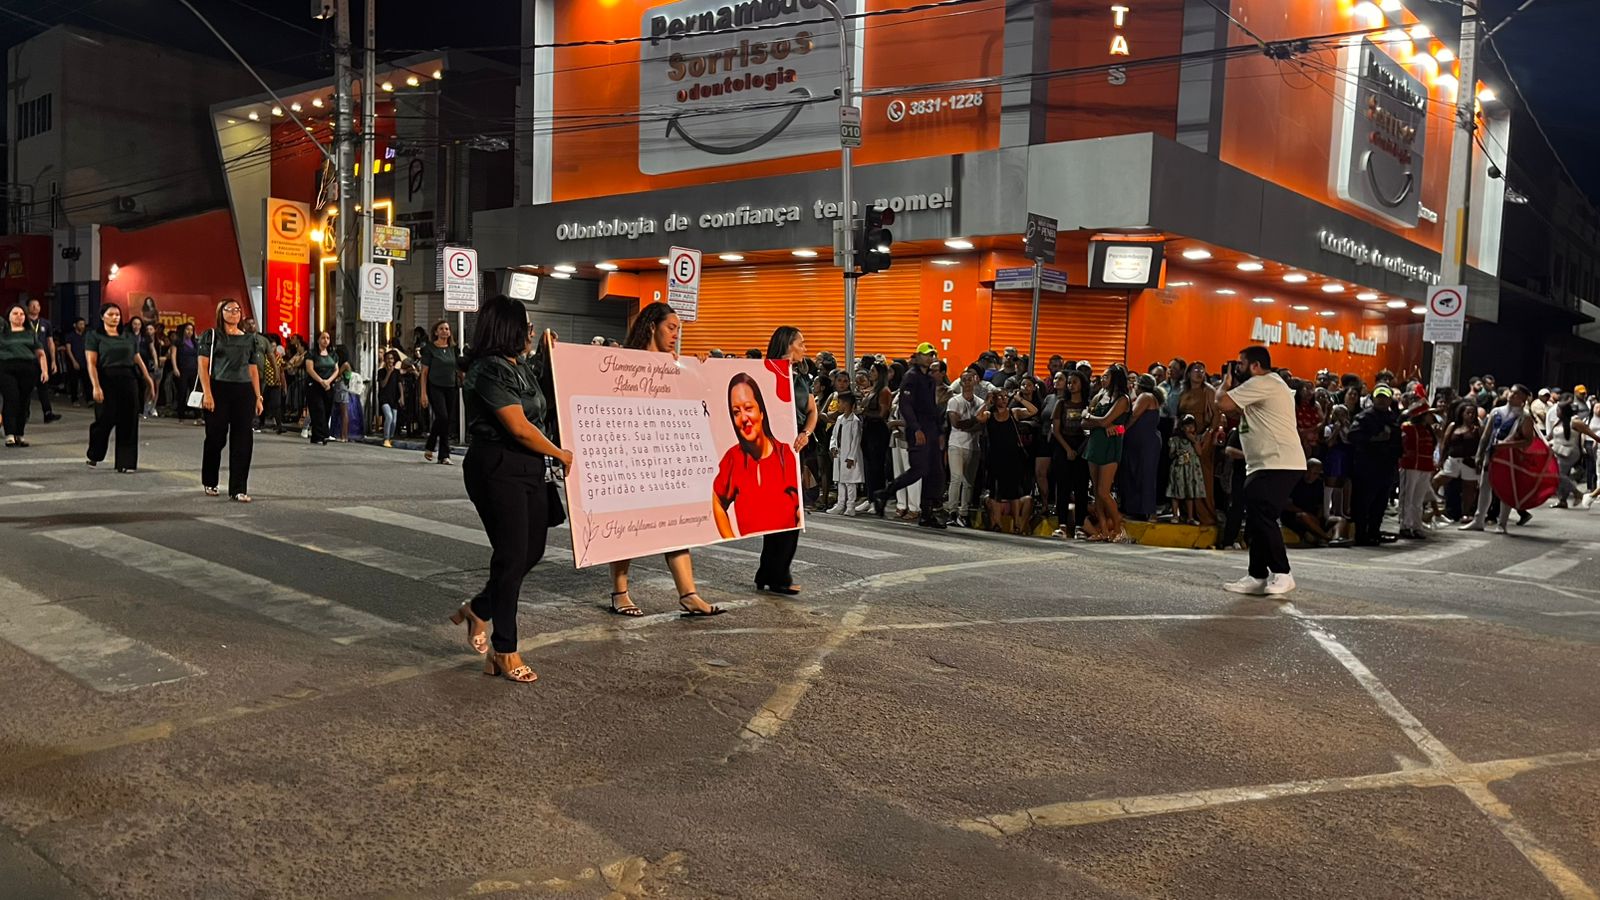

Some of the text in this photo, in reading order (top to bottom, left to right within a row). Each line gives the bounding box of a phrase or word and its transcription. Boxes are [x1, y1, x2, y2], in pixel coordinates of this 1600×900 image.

[668, 31, 815, 81] Sorrisos
[676, 67, 797, 103] odontologia
[909, 91, 983, 115] 3831-1228
[841, 126, 860, 137] 010
[281, 211, 297, 233] E
[556, 217, 655, 241] Odontologia
[664, 213, 689, 232] de
[699, 205, 800, 229] confiança
[457, 258, 465, 271] E
[680, 261, 688, 277] E
[374, 272, 382, 285] E
[279, 280, 293, 323] Ultra
[1251, 317, 1282, 347] Aqui
[1286, 322, 1315, 348] Você
[1319, 327, 1344, 351] Pode
[577, 404, 698, 417] Professora Lidiana, você
[578, 418, 692, 428] será eterna em nossos
[580, 431, 700, 444] corações. Sua luz nunca
[582, 442, 703, 458] apagará, sua missão foi
[585, 459, 629, 470] ensinar,
[632, 457, 672, 468] inspirar
[686, 454, 712, 464] amar.
[587, 466, 714, 484] Seguimos seu legado com
[588, 480, 690, 499] gratidão e saudade.
